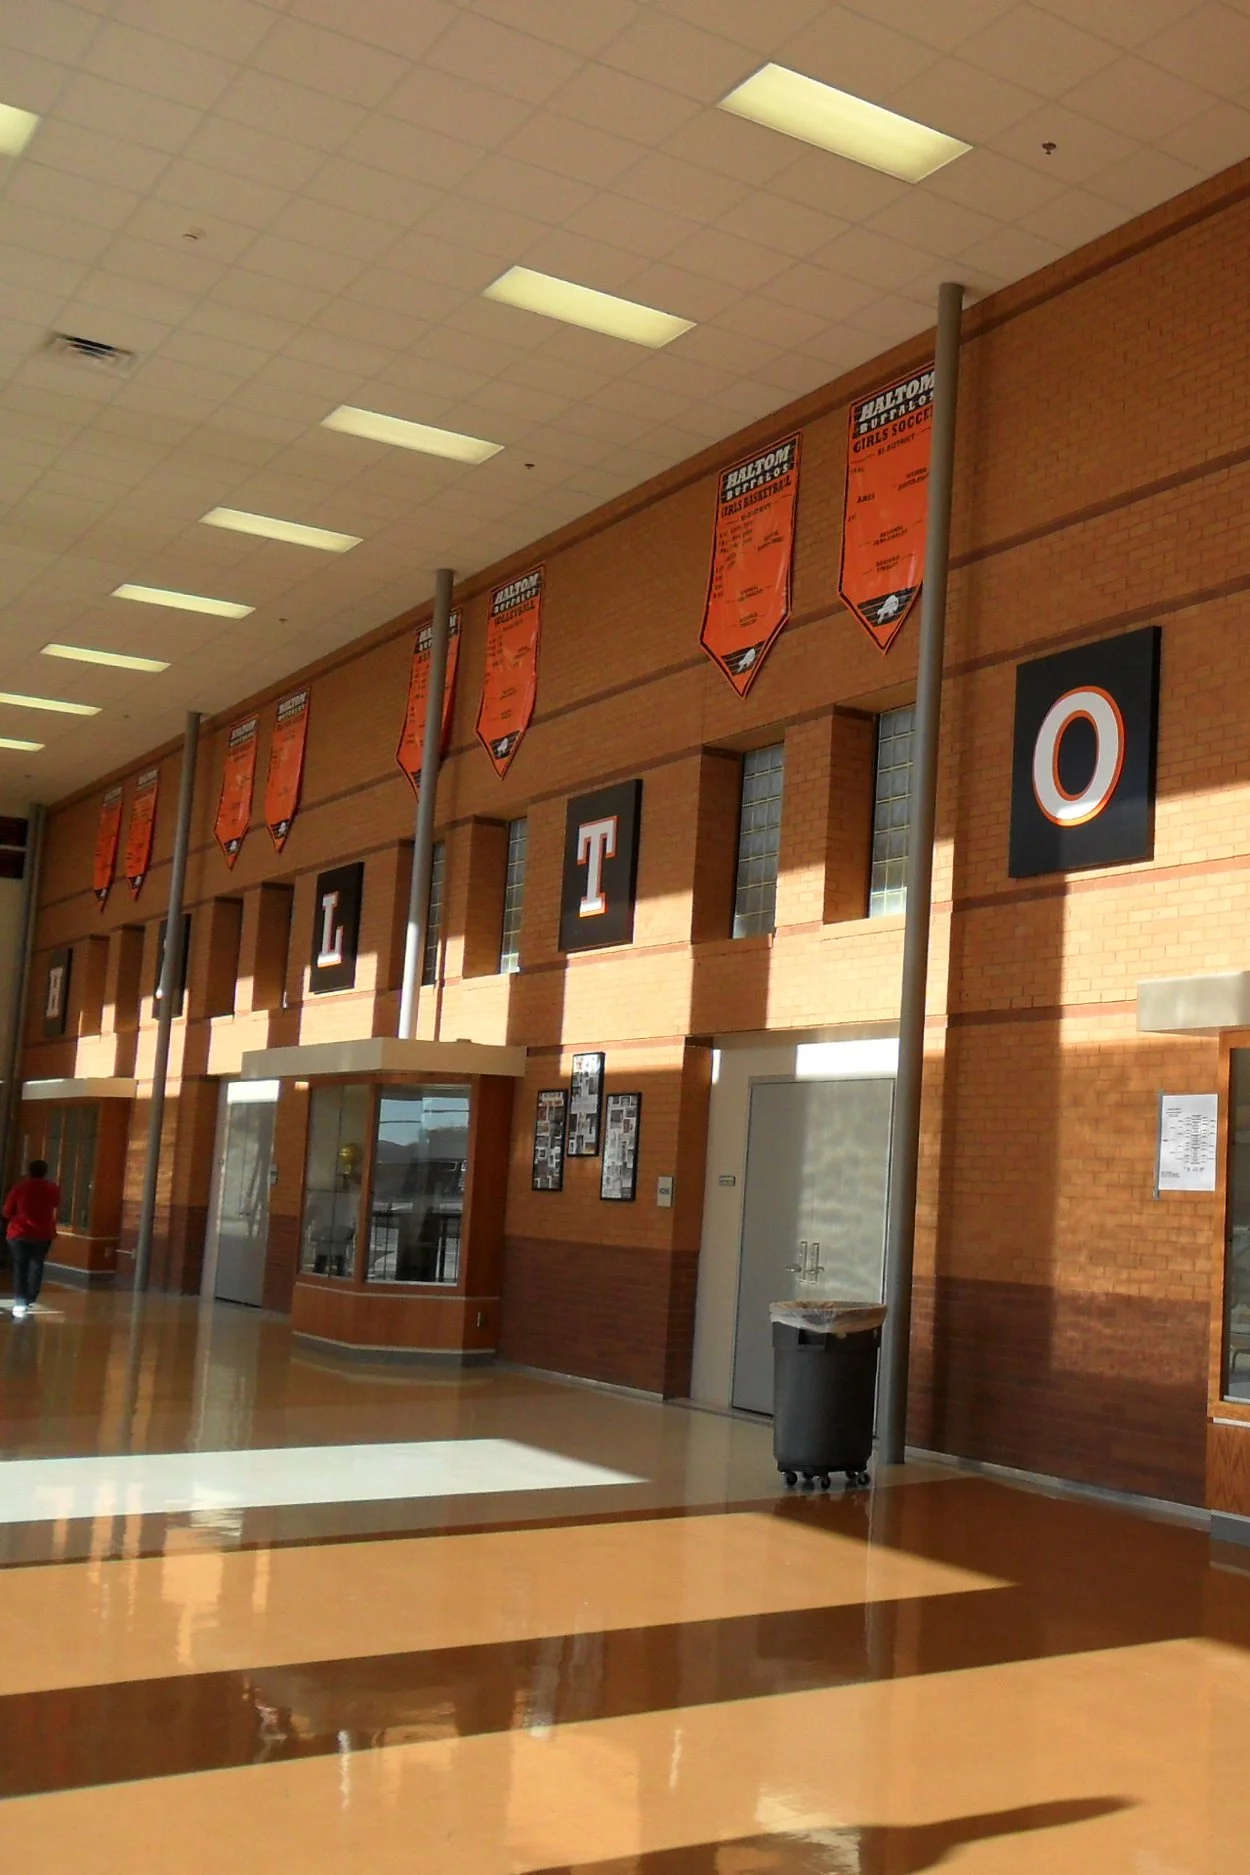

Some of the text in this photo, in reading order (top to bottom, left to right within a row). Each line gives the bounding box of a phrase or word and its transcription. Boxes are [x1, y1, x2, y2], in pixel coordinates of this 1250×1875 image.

[858, 371, 935, 422] HALTOM
[853, 404, 934, 453] GIRLS SOCCE
[725, 444, 791, 490] HALTOM
[726, 463, 789, 500] BUFFALOS
[494, 572, 539, 605] HALTOM
[316, 891, 344, 968] L
[577, 815, 618, 918] T
[1032, 685, 1125, 827] O
